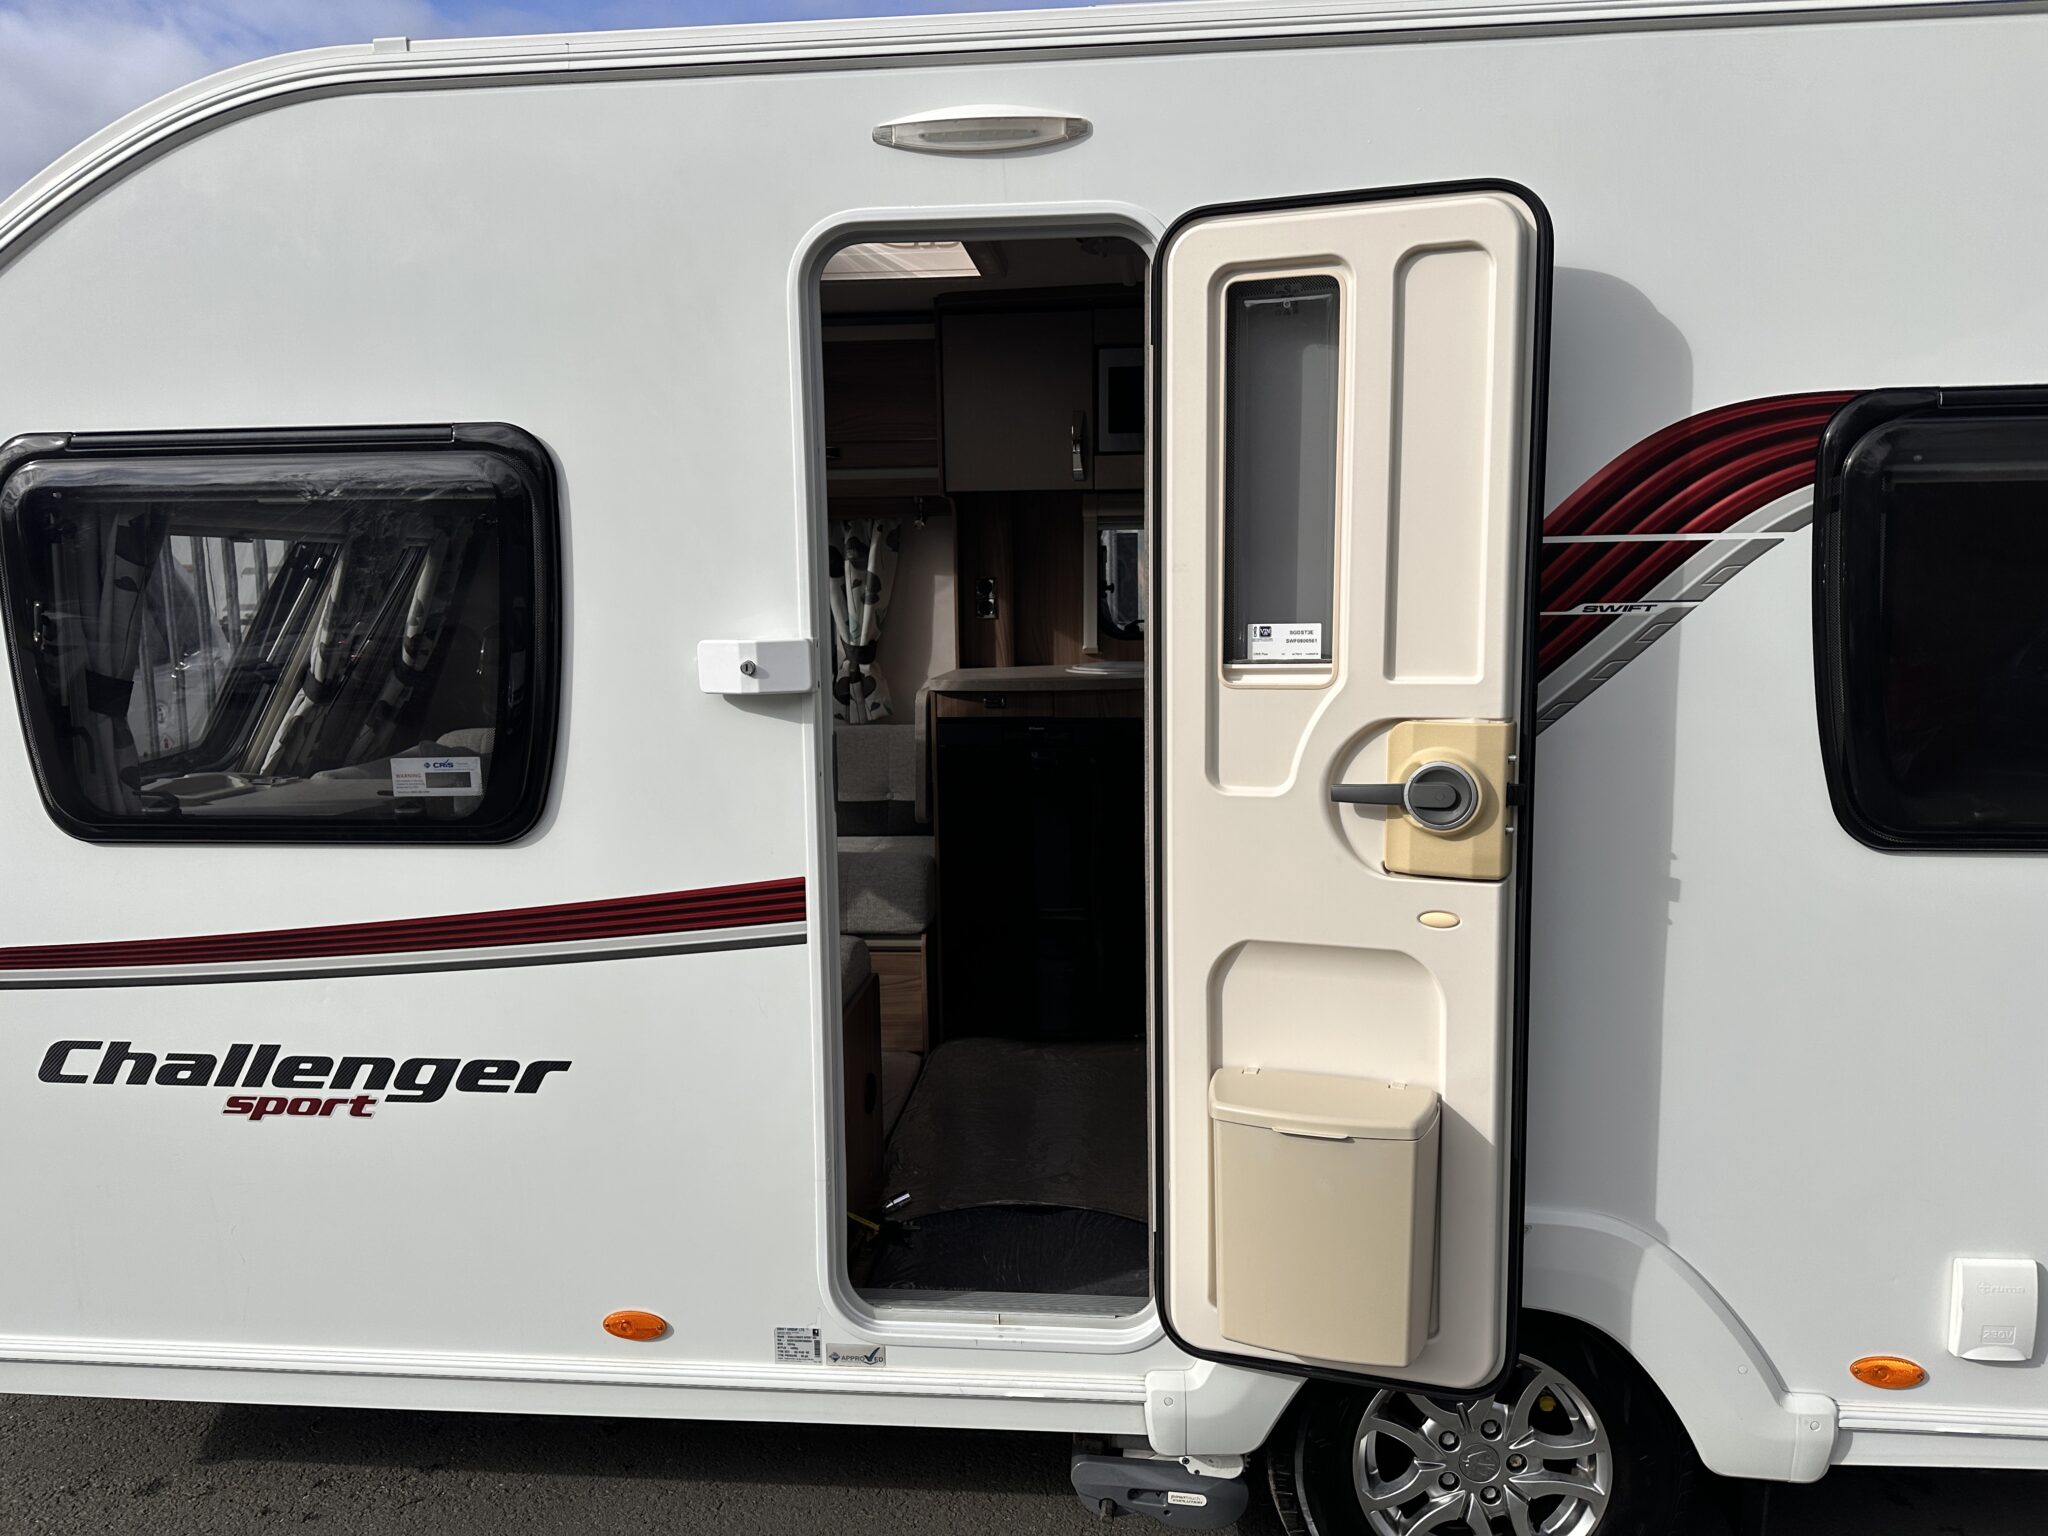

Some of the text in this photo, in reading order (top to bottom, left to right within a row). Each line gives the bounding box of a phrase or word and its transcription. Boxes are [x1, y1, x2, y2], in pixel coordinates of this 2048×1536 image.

[1582, 604, 1658, 613] SWIFT
[37, 1040, 573, 1103] Challenger
[223, 1094, 377, 1121] sport
[1983, 1330, 2013, 1339] 230V
